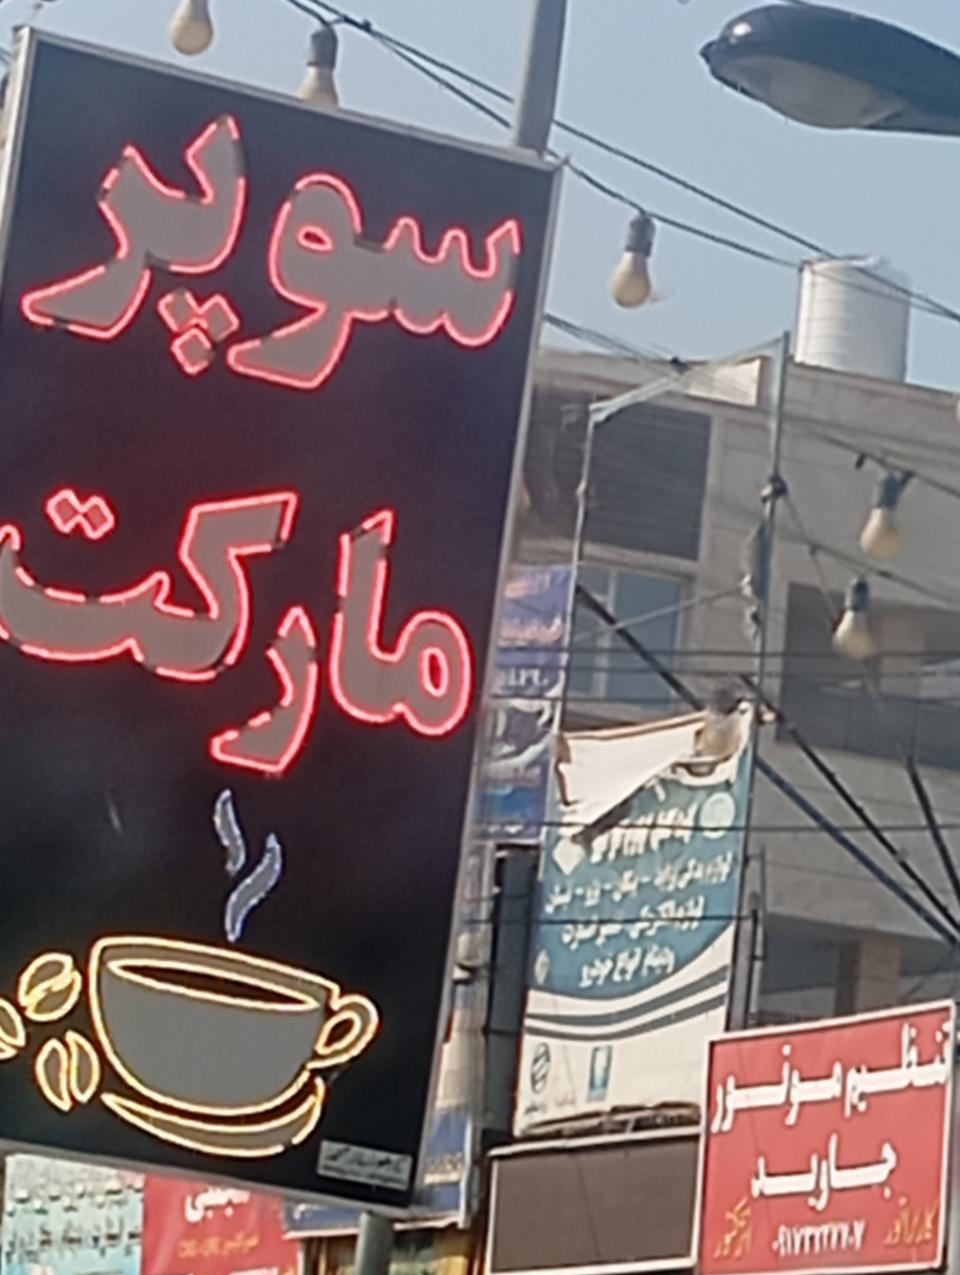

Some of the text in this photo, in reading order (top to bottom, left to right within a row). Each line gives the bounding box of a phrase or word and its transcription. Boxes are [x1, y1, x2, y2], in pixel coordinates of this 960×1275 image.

[22, 114, 521, 389] سوپر
[0, 489, 473, 775] مارکت
[710, 1019, 952, 1134] تنظیم موتور
[751, 1133, 898, 1211] جاوید
